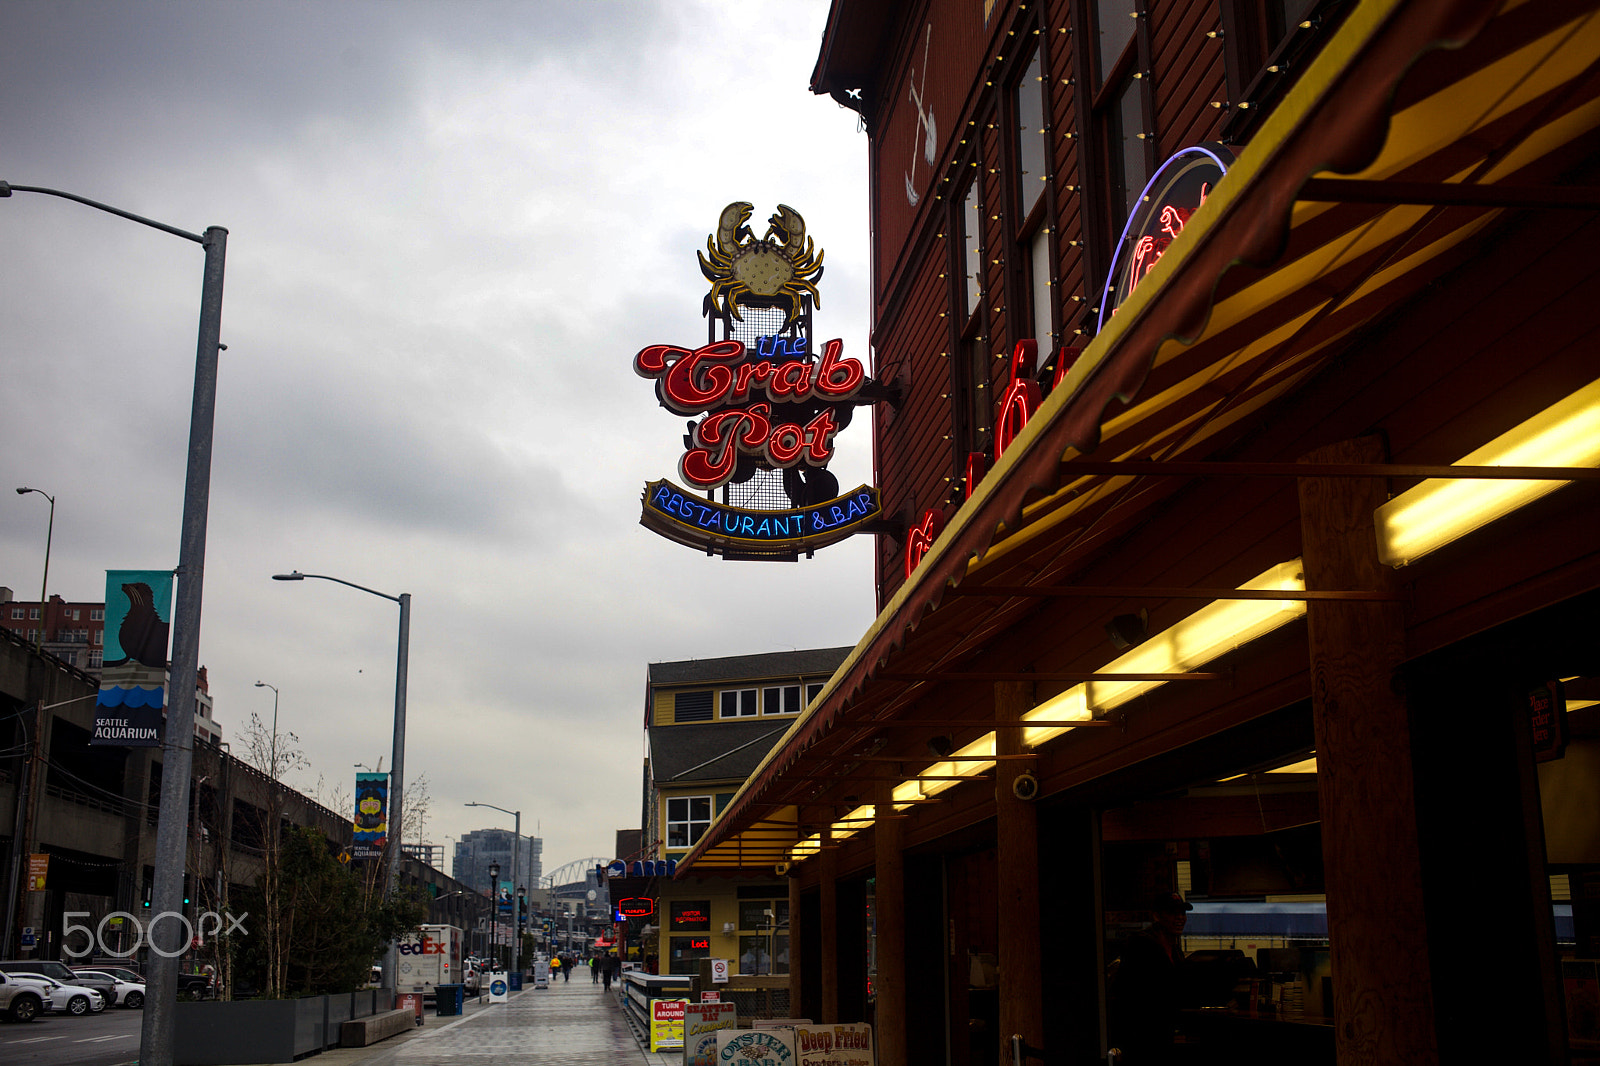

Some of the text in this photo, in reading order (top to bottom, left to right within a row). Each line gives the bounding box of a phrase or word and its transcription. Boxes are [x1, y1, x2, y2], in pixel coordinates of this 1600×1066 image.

[756, 333, 808, 359] the
[634, 338, 864, 411] Crab
[679, 401, 839, 489] Pot
[652, 486, 876, 537] RESTAURANT & BAR
[95, 718, 129, 727] SEATTLE
[1531, 710, 1550, 727] rder
[94, 727, 158, 740] AQUARIUM
[397, 936, 447, 955] edEx
[691, 939, 709, 949] Lock
[656, 1010, 684, 1018] AROUND
[686, 1004, 734, 1014] SEATTLE
[702, 1013, 720, 1022] BAY
[721, 1032, 792, 1061] OYSTER
[798, 1025, 871, 1055] Deep Fried
